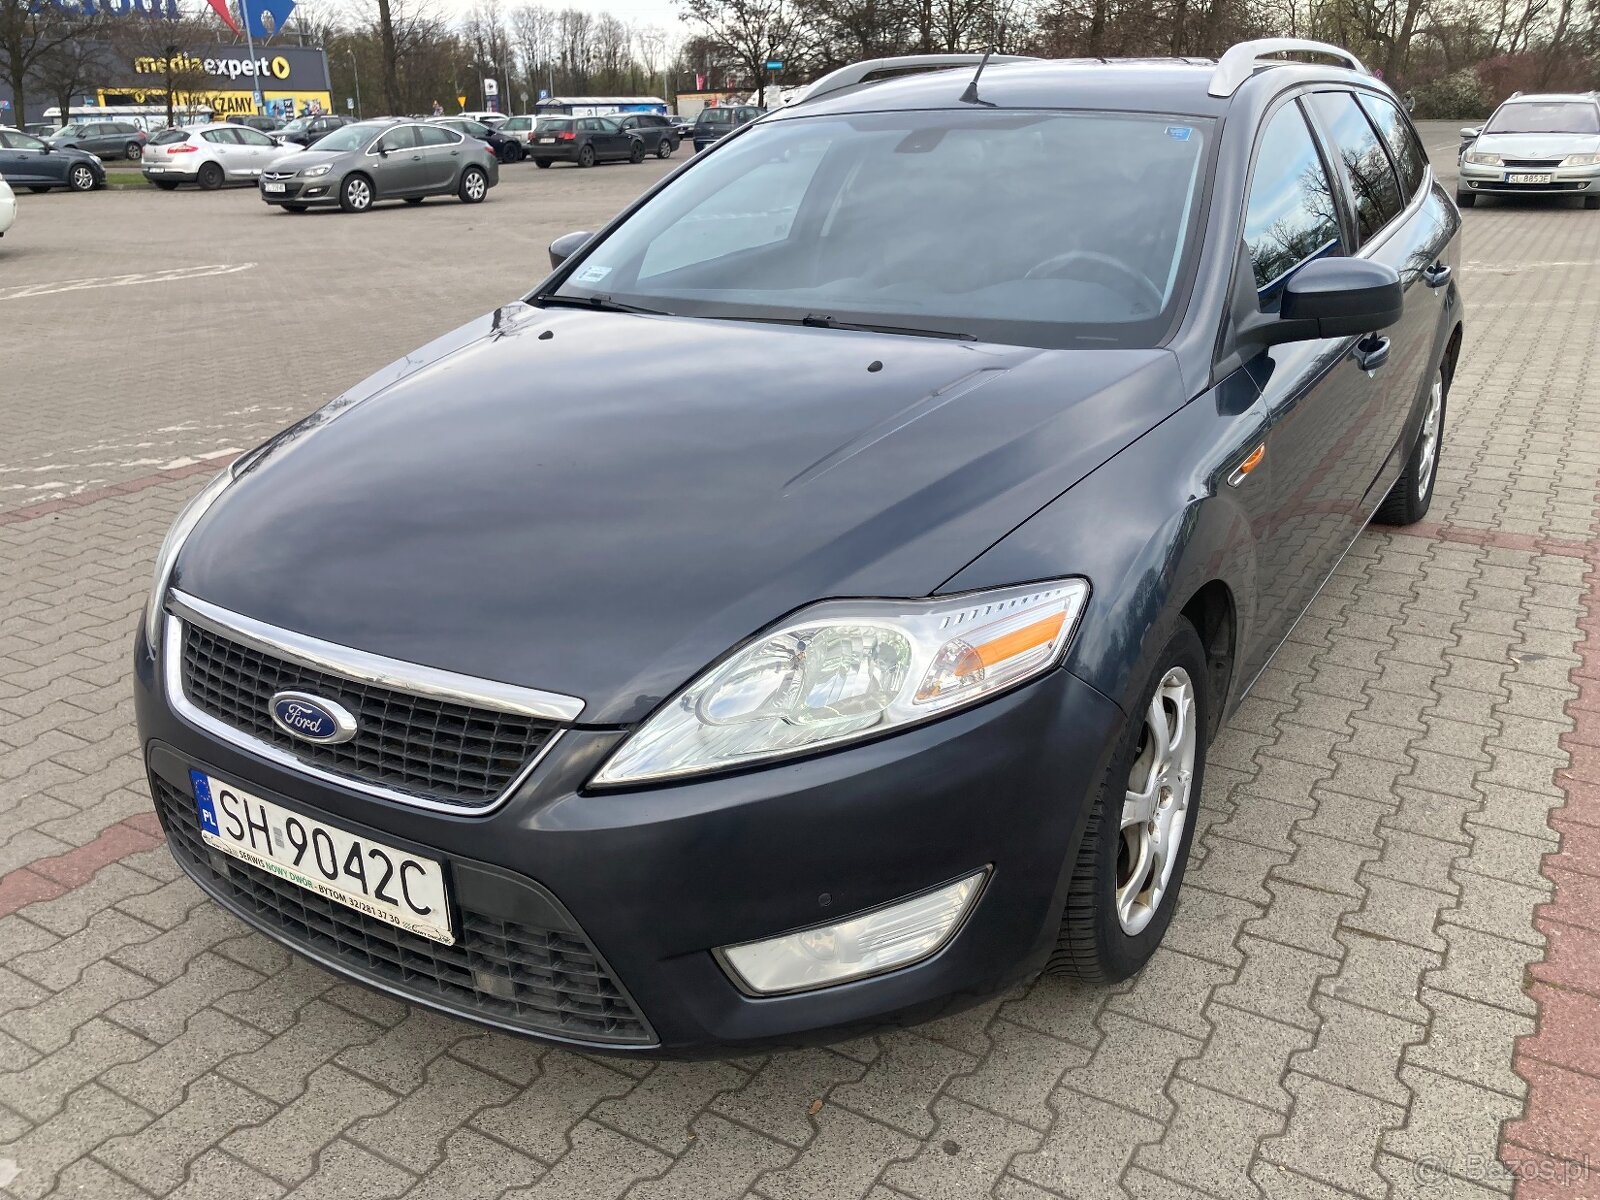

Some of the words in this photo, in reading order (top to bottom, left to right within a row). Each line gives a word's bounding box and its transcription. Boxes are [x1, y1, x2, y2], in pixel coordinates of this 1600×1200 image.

[284, 703, 323, 733] Ford
[202, 808, 217, 827] PL
[219, 789, 273, 857] SH
[285, 816, 432, 917] 9042C
[238, 850, 266, 868] SERWIS
[265, 862, 289, 877] NOWY
[288, 871, 313, 888] DWÓR
[318, 884, 347, 903] BYTOM
[349, 897, 376, 914] 32/281
[378, 909, 388, 920] 37
[389, 913, 401, 925] 30
